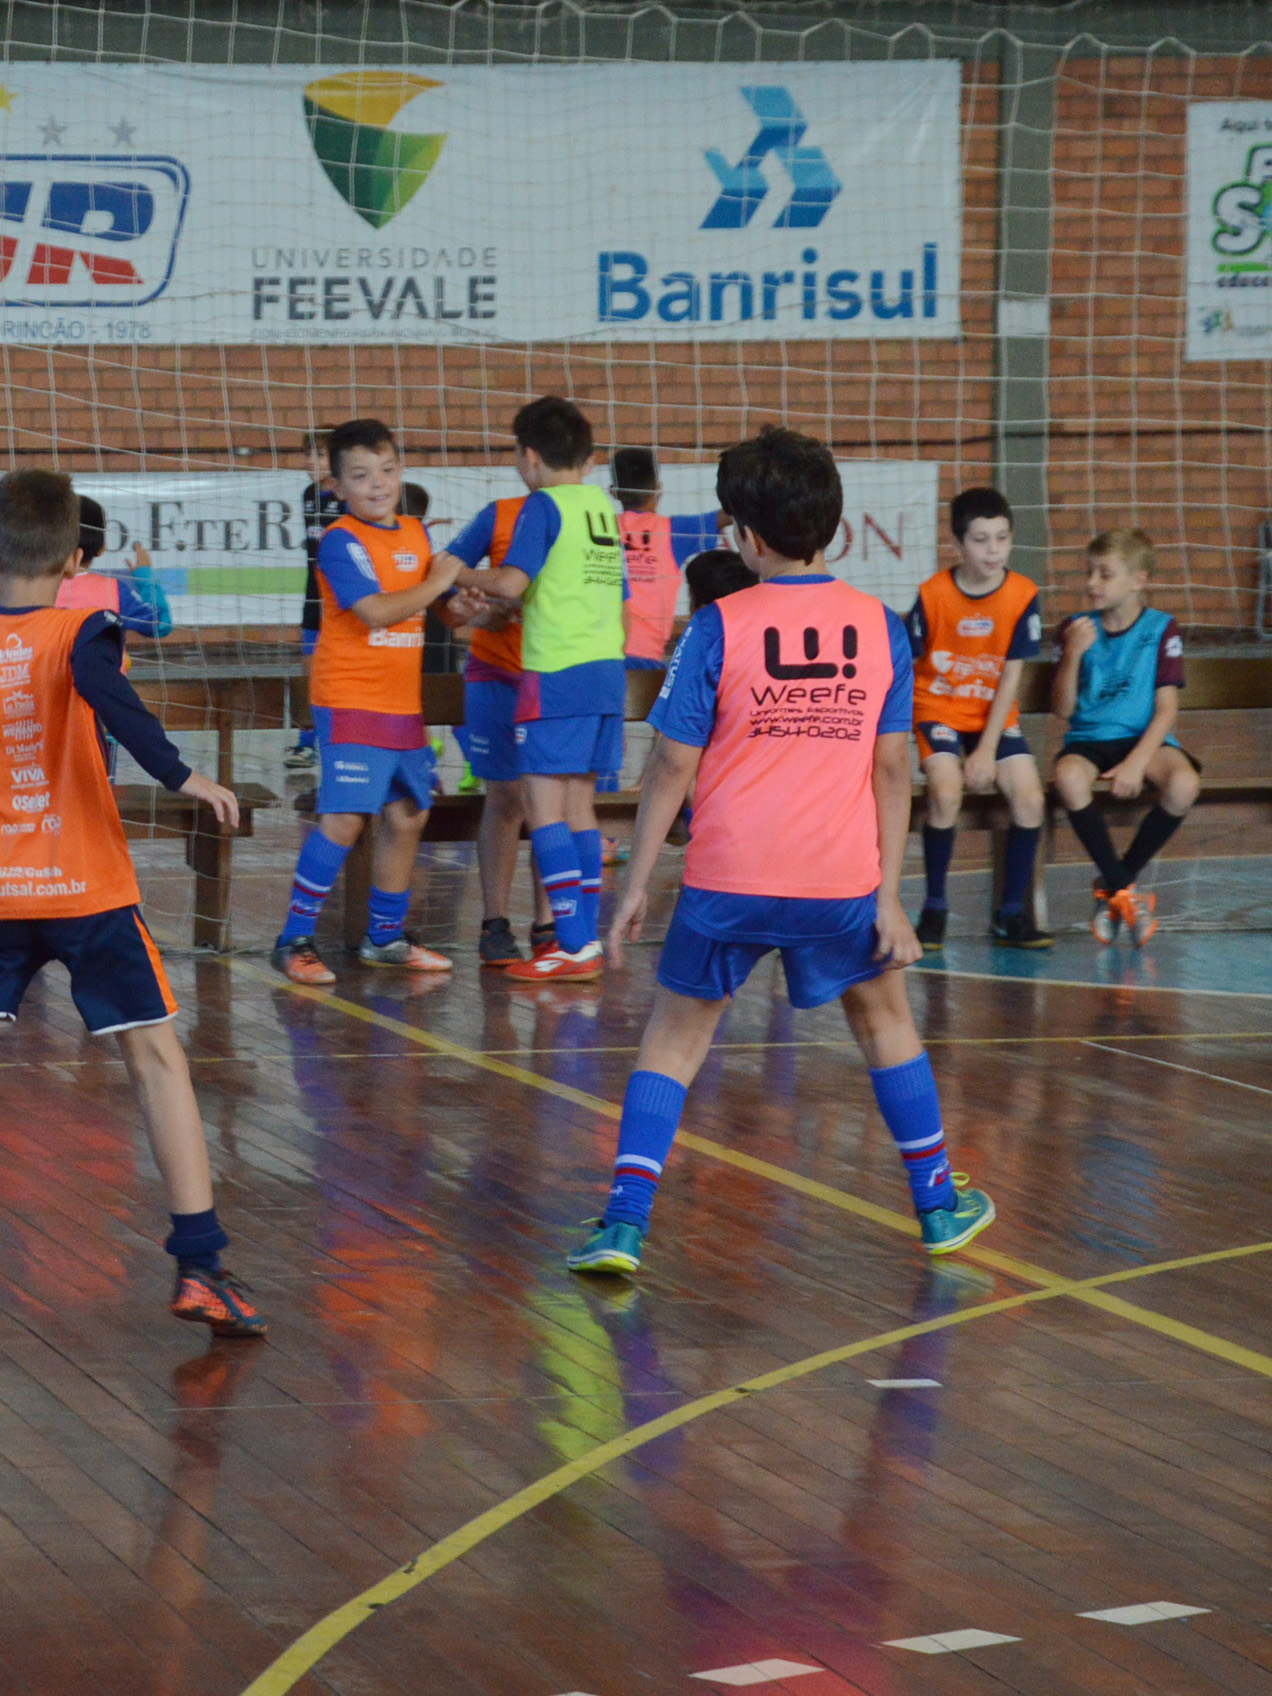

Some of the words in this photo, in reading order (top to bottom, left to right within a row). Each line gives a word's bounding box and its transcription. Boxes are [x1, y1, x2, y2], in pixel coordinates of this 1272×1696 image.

[251, 247, 498, 268] UNIVERSIDADE
[597, 242, 938, 322] Banrisul
[253, 275, 498, 321] FEEVALE
[106, 320, 152, 339] 1978
[750, 683, 867, 706] Weefe
[749, 715, 864, 727] www.weefe.com.br
[11, 767, 45, 784] VIVA
